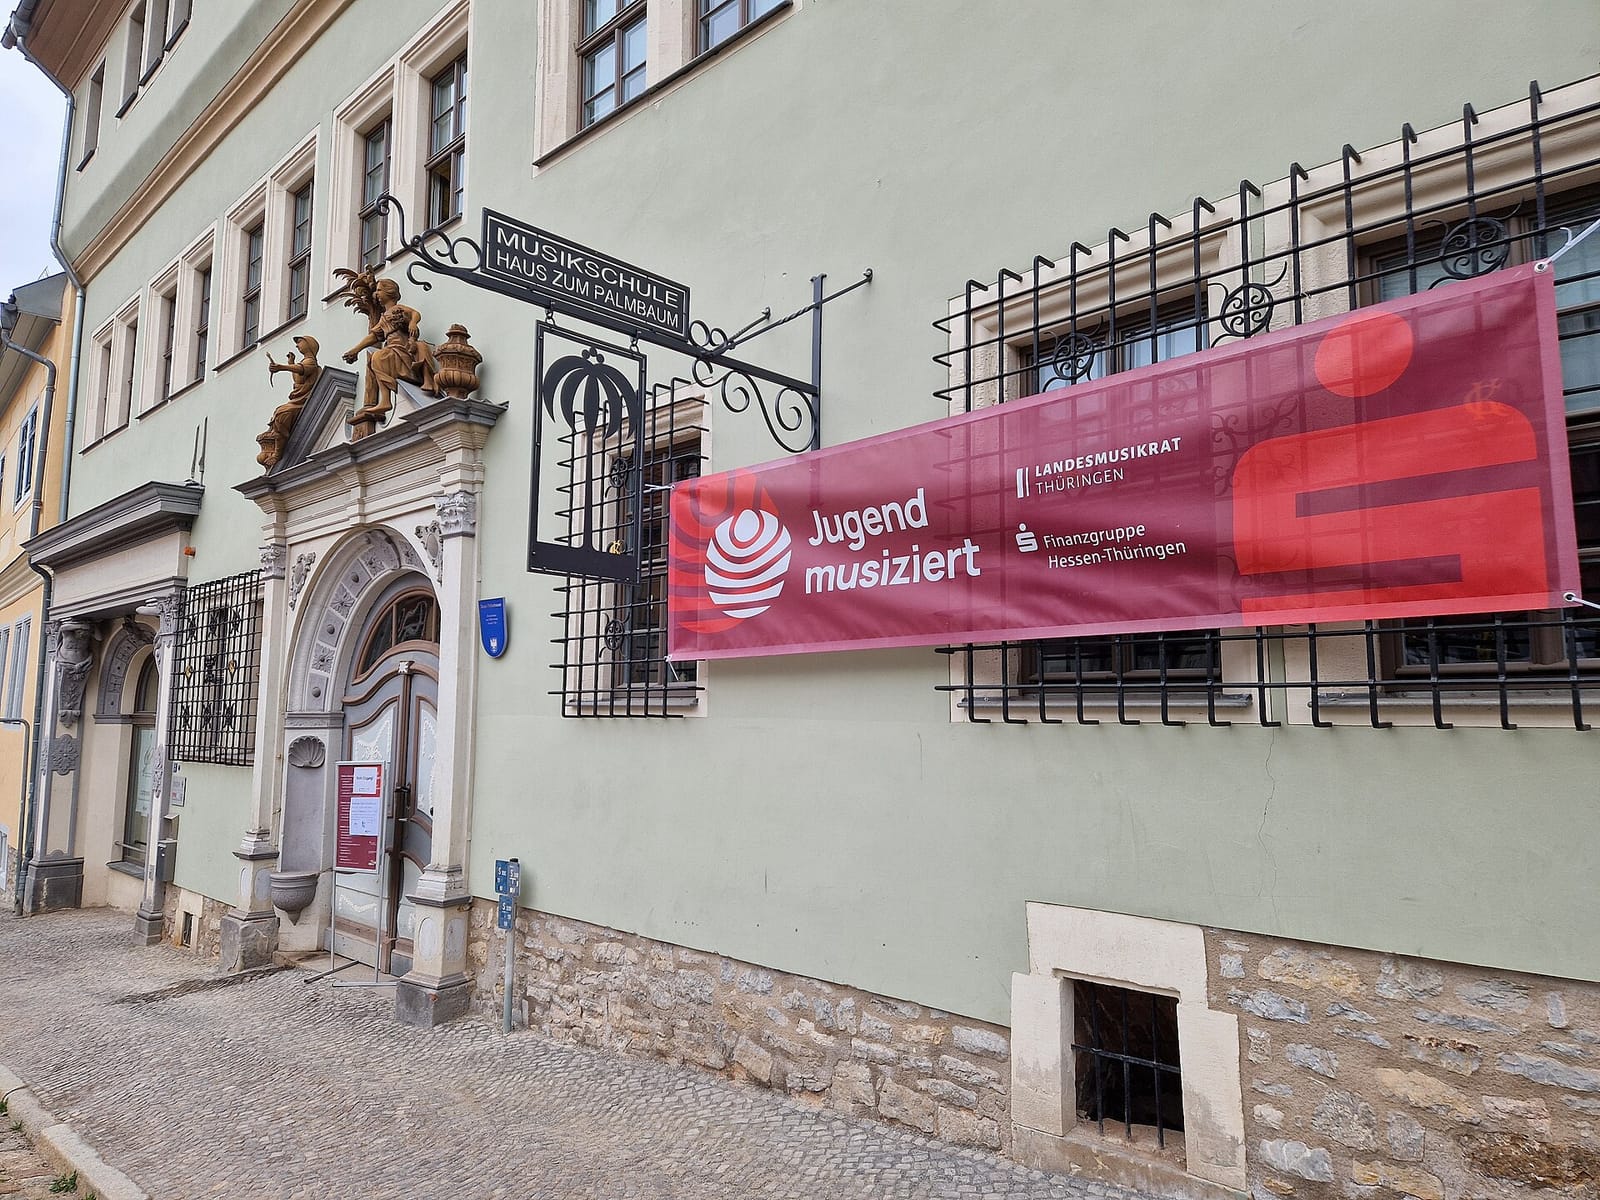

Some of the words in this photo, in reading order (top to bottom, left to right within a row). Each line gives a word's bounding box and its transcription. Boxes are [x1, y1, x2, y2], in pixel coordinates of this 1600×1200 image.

[497, 226, 679, 309] MUSIKSCHULE
[497, 252, 547, 282] HAUS
[552, 269, 589, 297] ZUM
[594, 285, 679, 329] PALMBAUM
[1035, 437, 1182, 477] LANDESMUSIKRAT
[1035, 467, 1125, 495] THÜRINGEN
[808, 487, 929, 551] Jugend
[1043, 524, 1146, 550] Finanzgruppe
[805, 538, 981, 594] musiziert
[1048, 541, 1187, 569] Hessen-Thüringen
